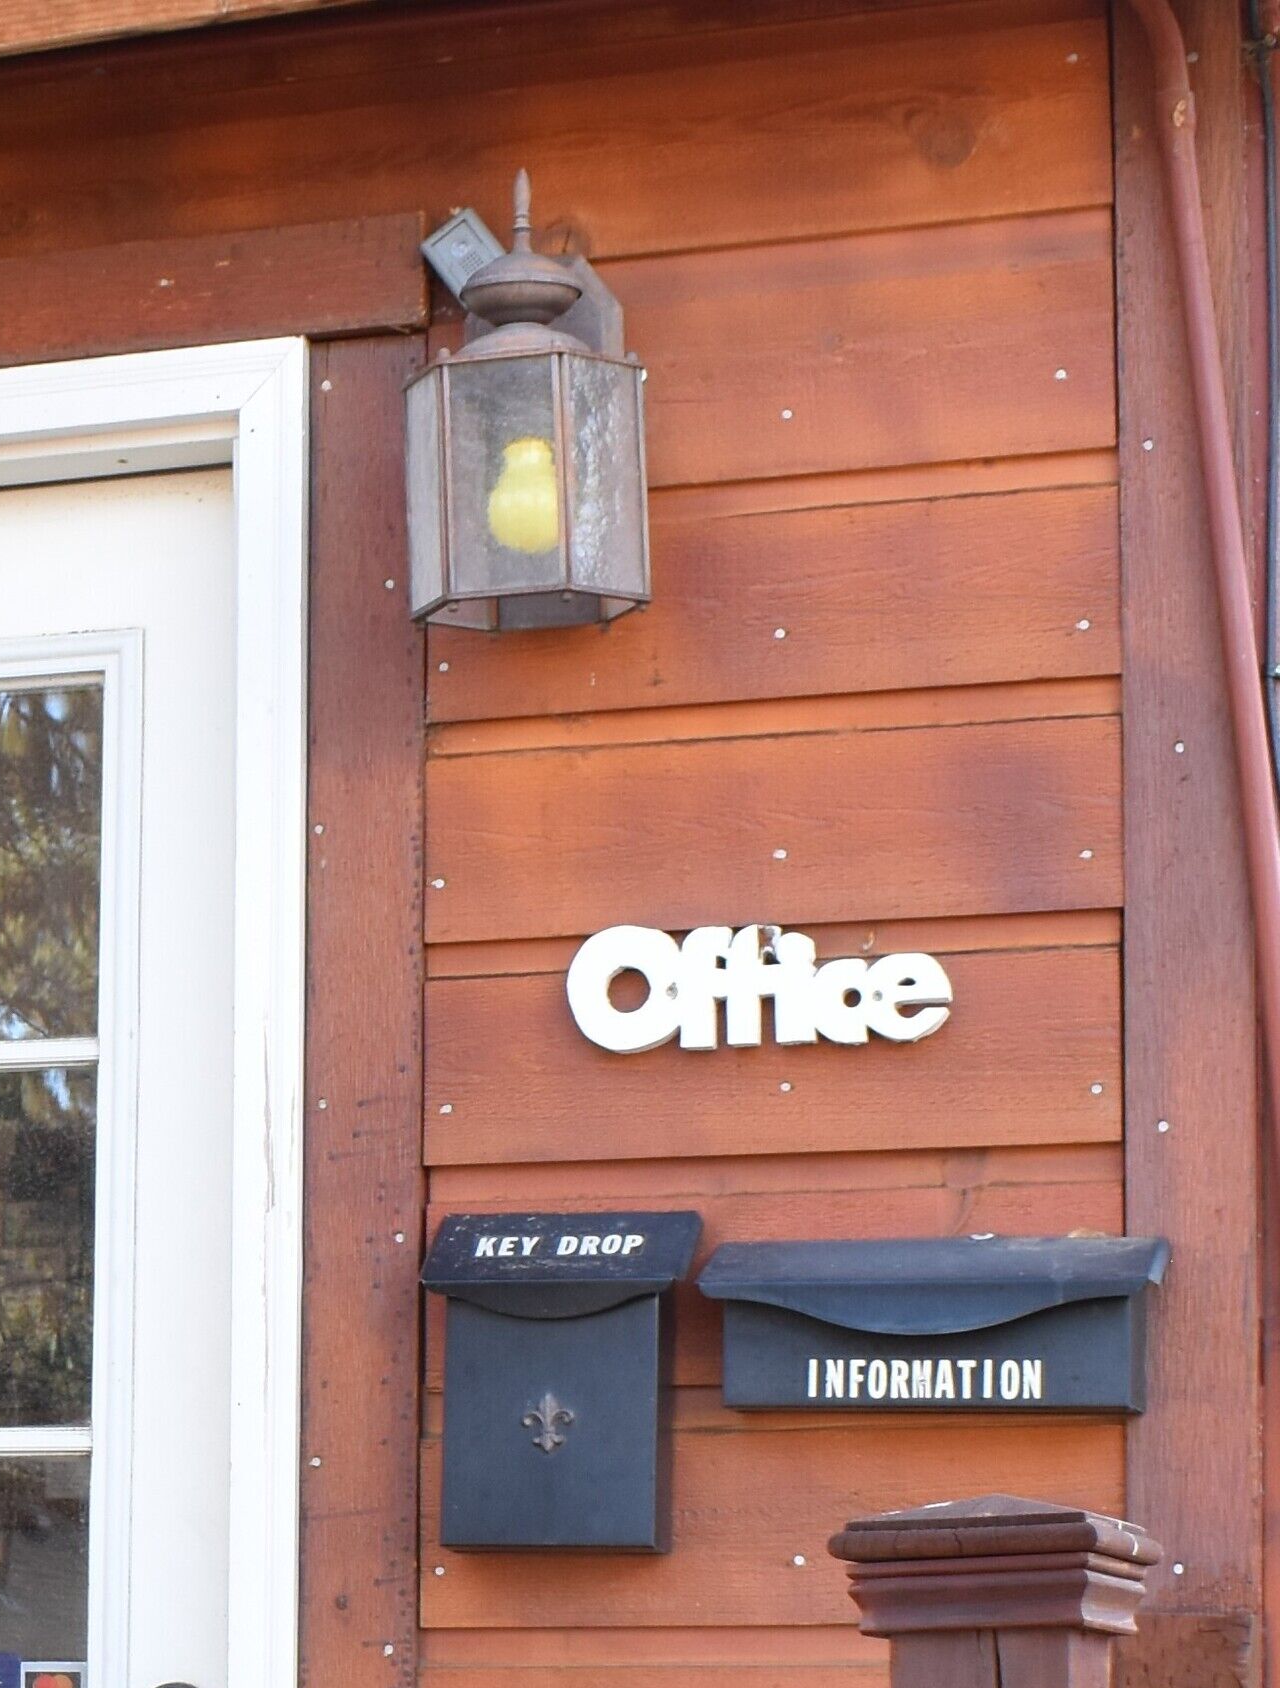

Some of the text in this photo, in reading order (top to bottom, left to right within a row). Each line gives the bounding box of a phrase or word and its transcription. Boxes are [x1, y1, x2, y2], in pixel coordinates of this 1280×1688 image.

[565, 924, 953, 1054] Office
[473, 1232, 645, 1258] KEY DROP
[806, 1357, 1043, 1401] INFORMATION
